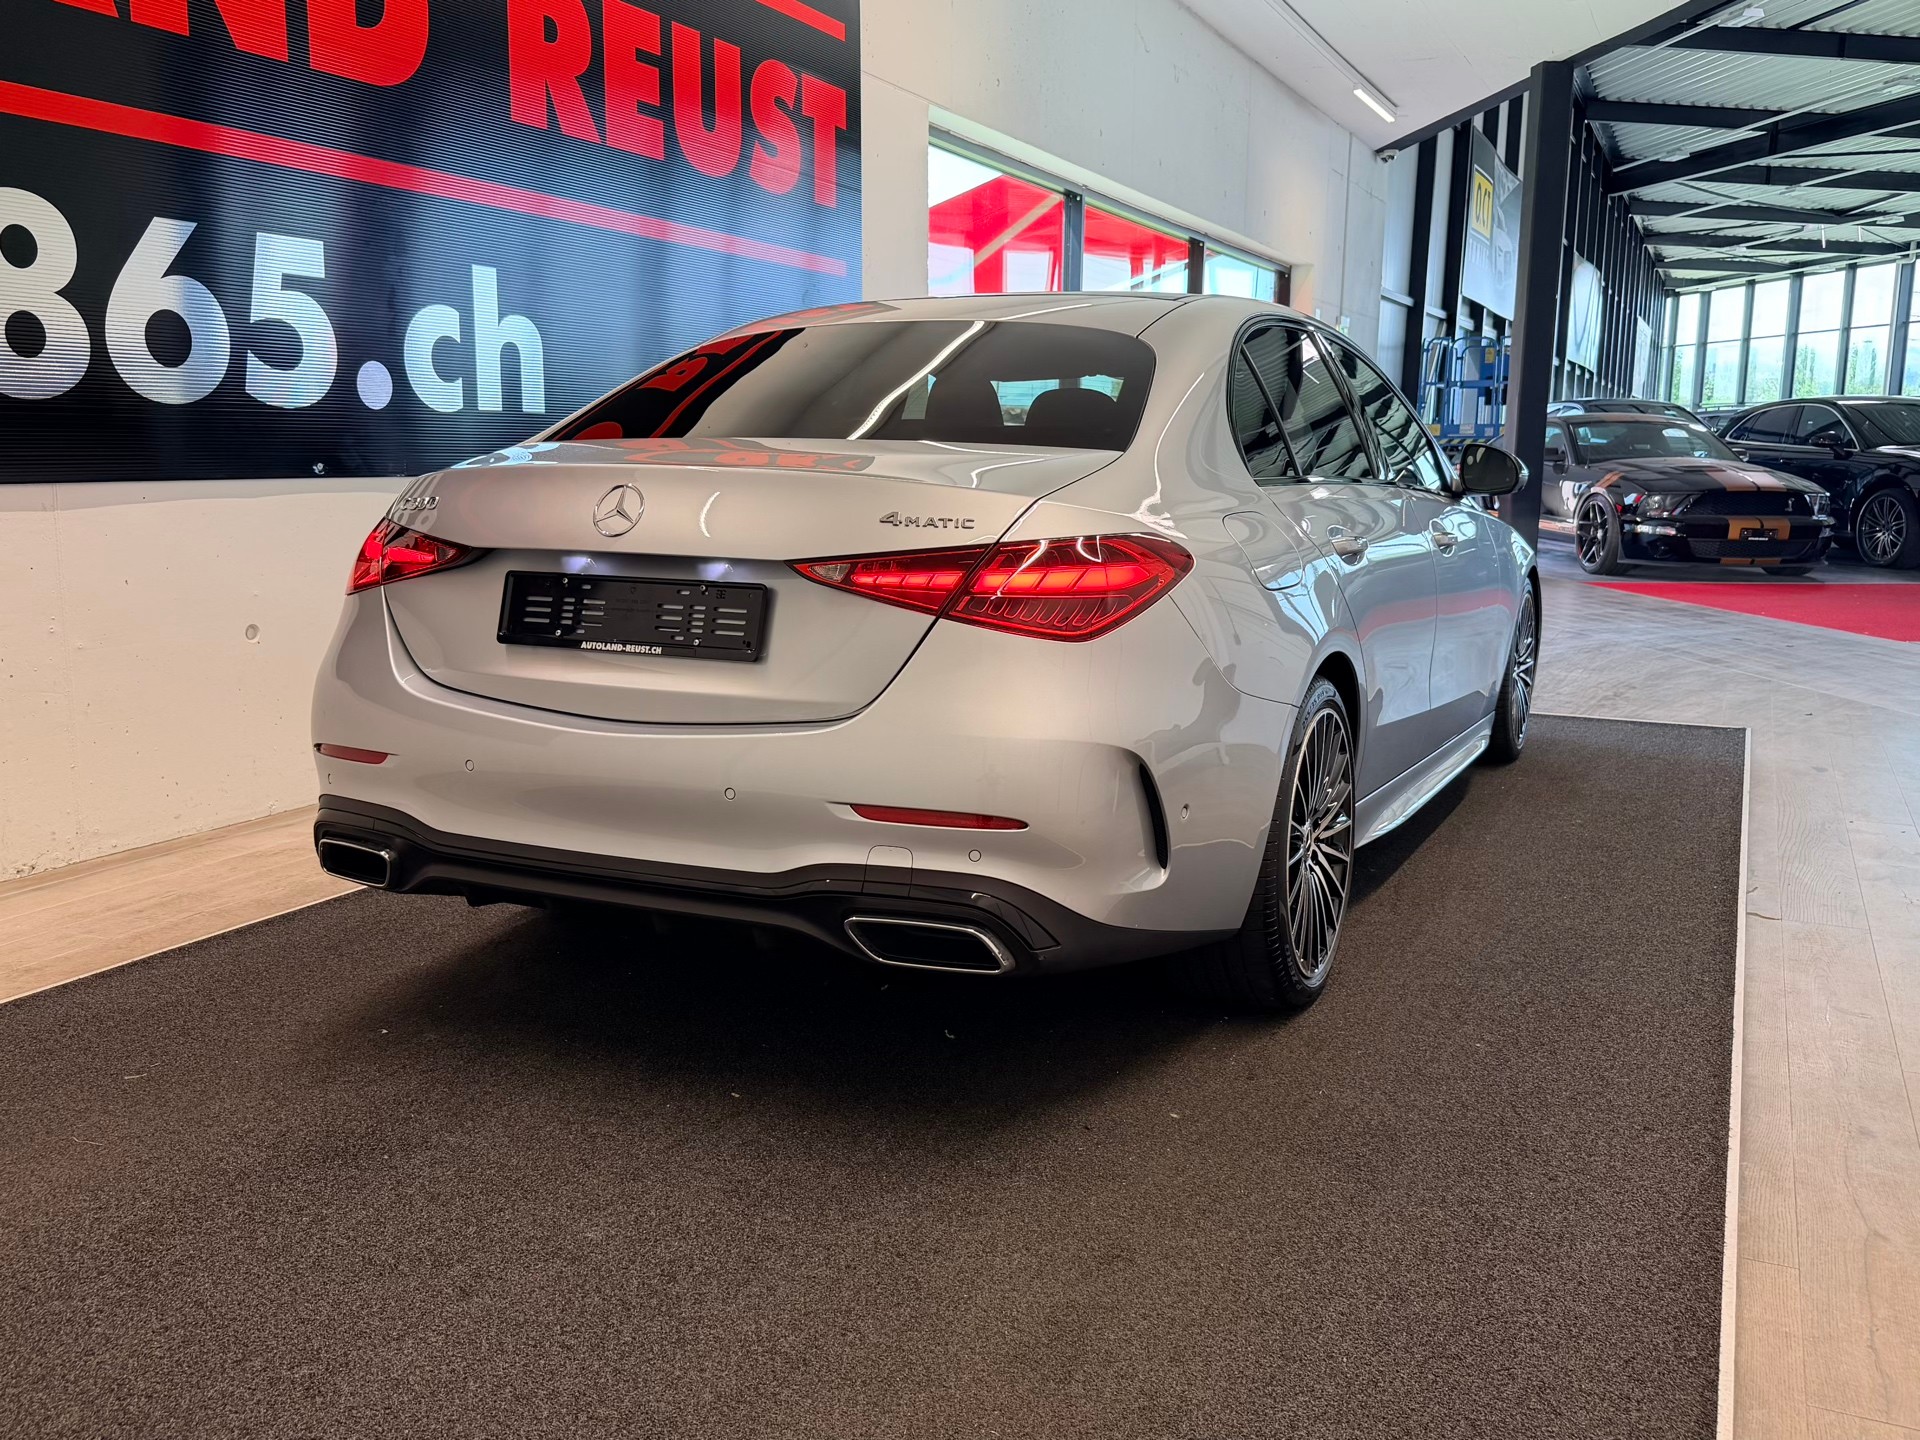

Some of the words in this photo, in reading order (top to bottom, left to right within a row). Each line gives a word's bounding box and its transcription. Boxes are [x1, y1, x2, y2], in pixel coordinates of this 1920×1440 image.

[507, 0, 846, 207] REUST
[0, 186, 546, 413] 865.ch
[879, 511, 975, 529] 4MATIC
[580, 641, 663, 655] AUTOLAND-REUST.CH
